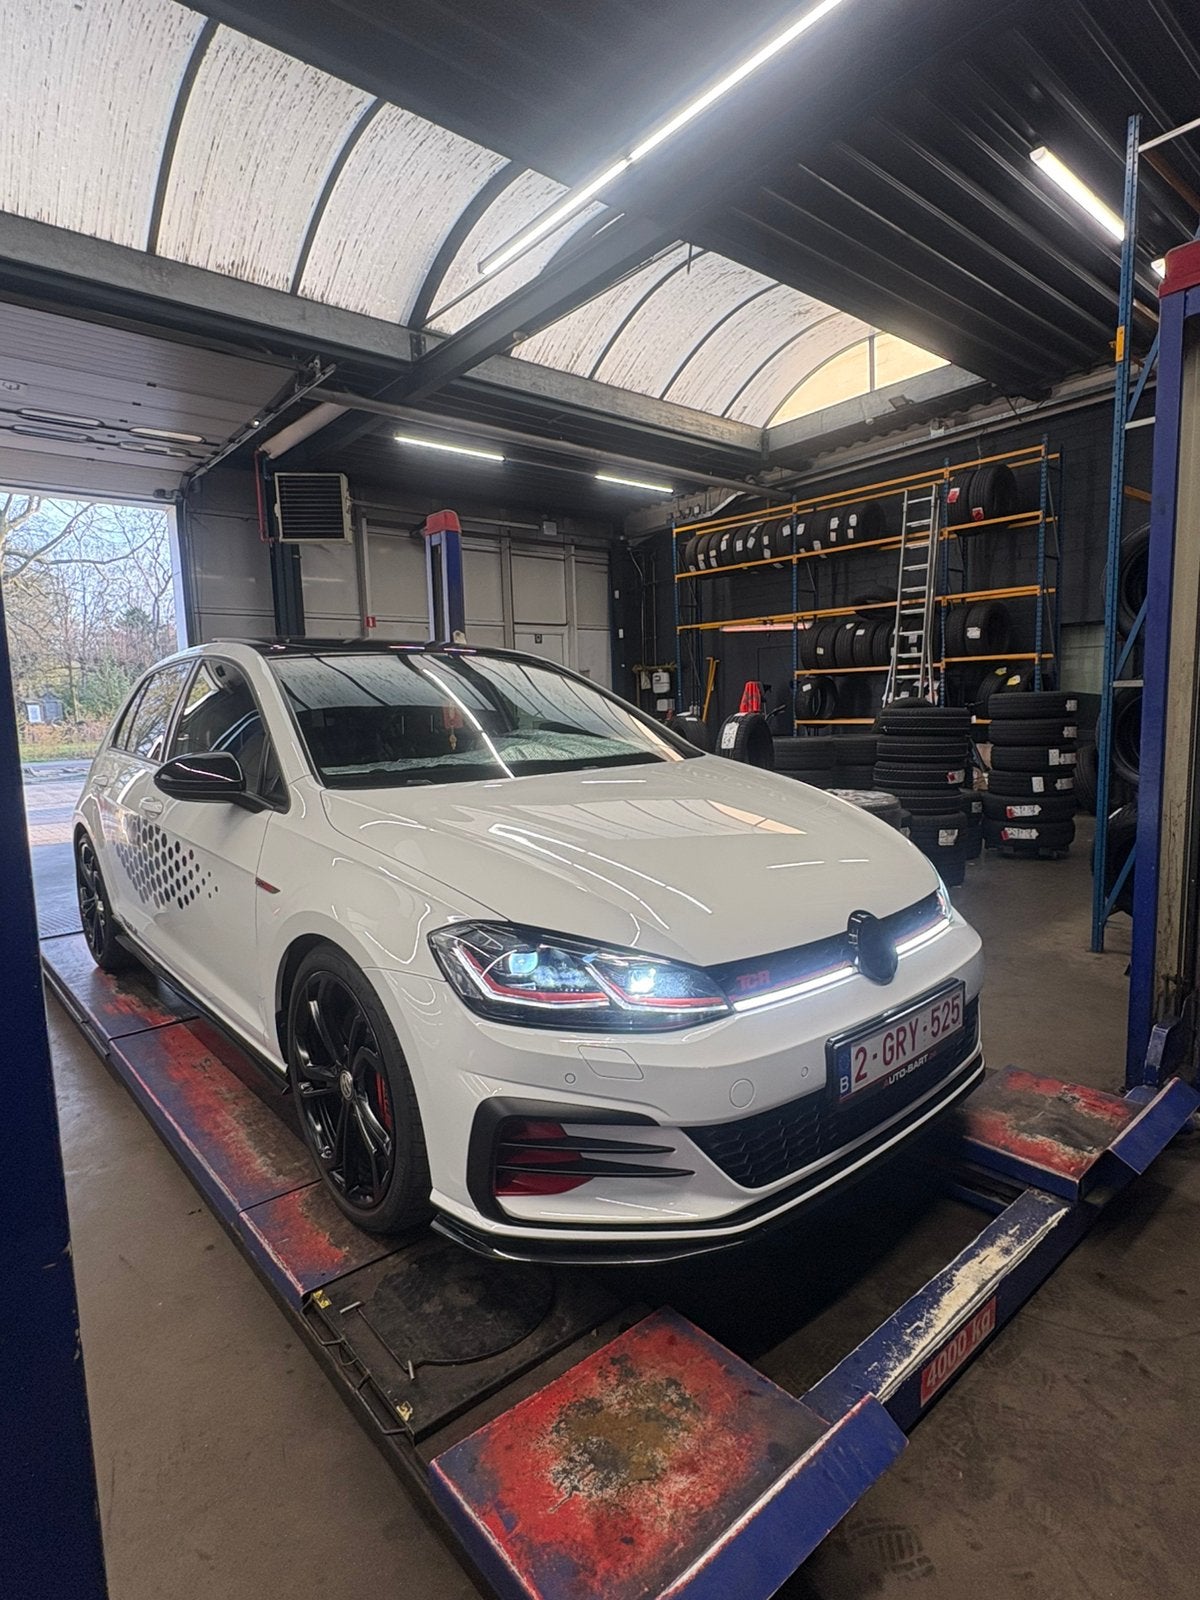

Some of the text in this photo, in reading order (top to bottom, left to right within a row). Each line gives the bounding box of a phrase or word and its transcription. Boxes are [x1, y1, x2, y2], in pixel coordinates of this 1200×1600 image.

[854, 994, 961, 1083] 2-GRY-525
[839, 1075, 849, 1094] B
[926, 1329, 967, 1387] 4000
